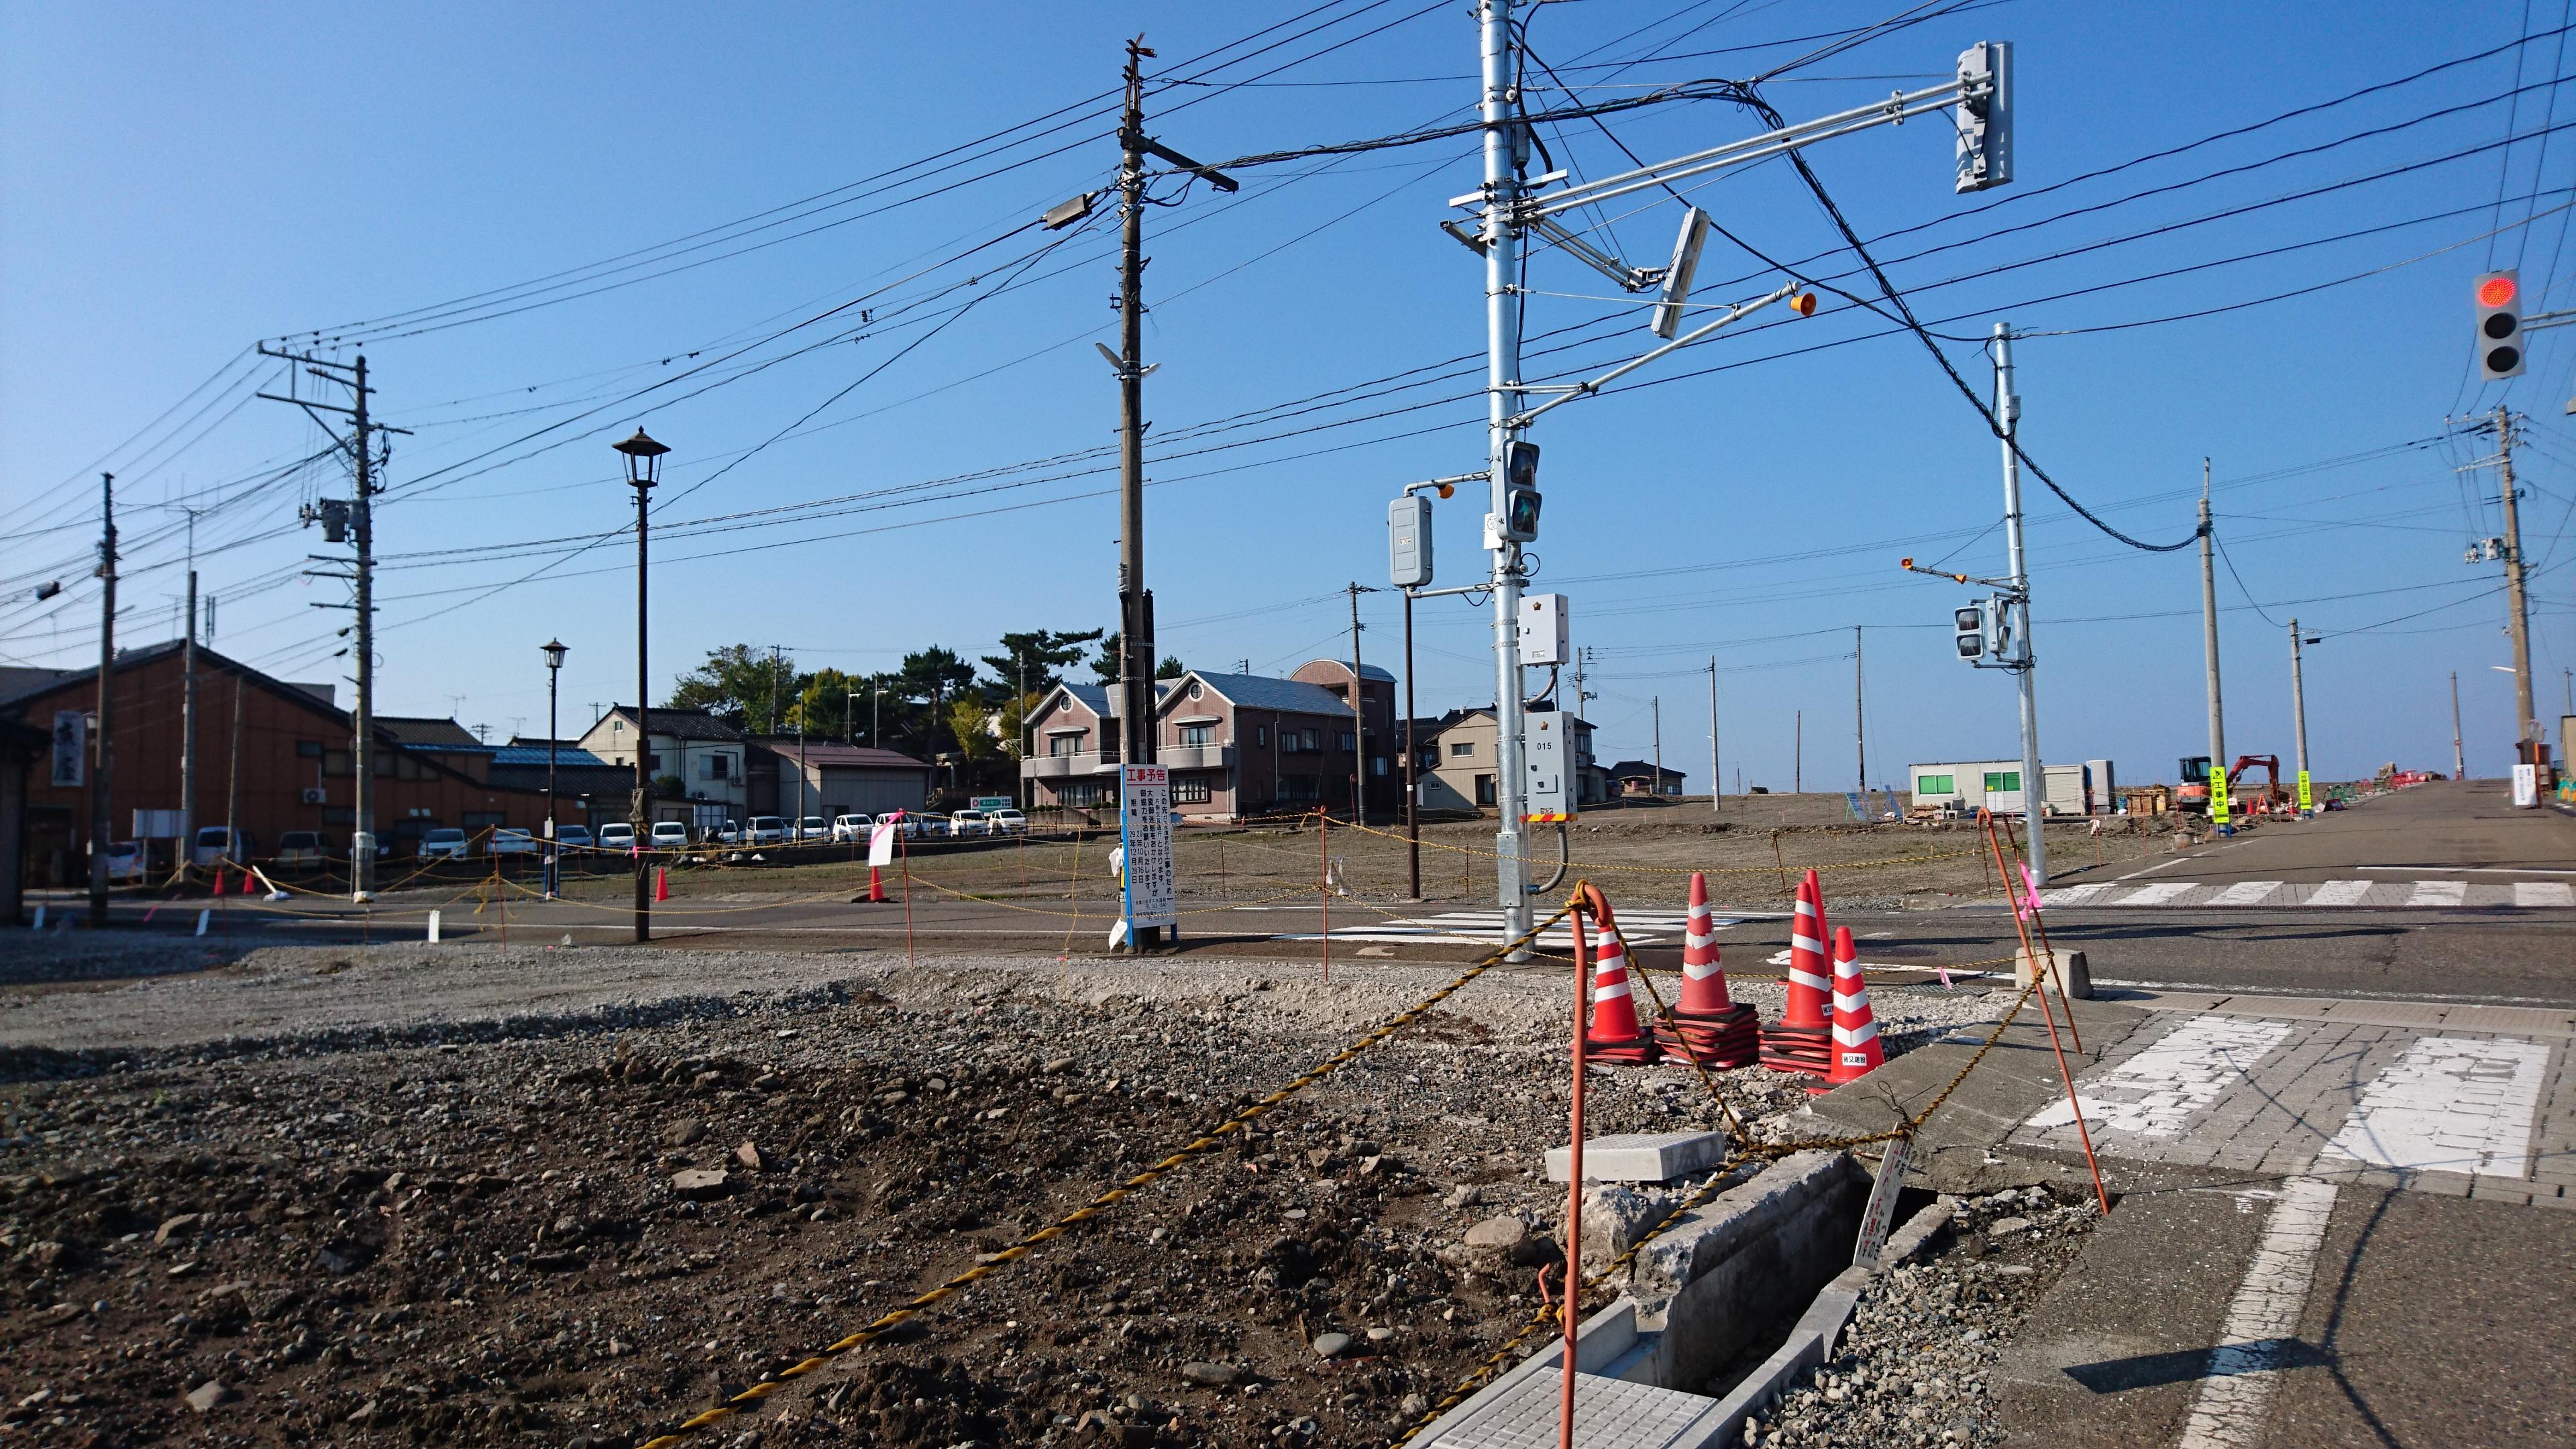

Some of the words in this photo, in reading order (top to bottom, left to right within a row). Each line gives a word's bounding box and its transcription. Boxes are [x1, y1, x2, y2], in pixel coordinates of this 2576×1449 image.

[1537, 742, 1552, 750] 015
[1127, 768, 1166, 782] 工事予告
[2214, 782, 2224, 808] 工事中
[1130, 799, 1138, 817] 期間
